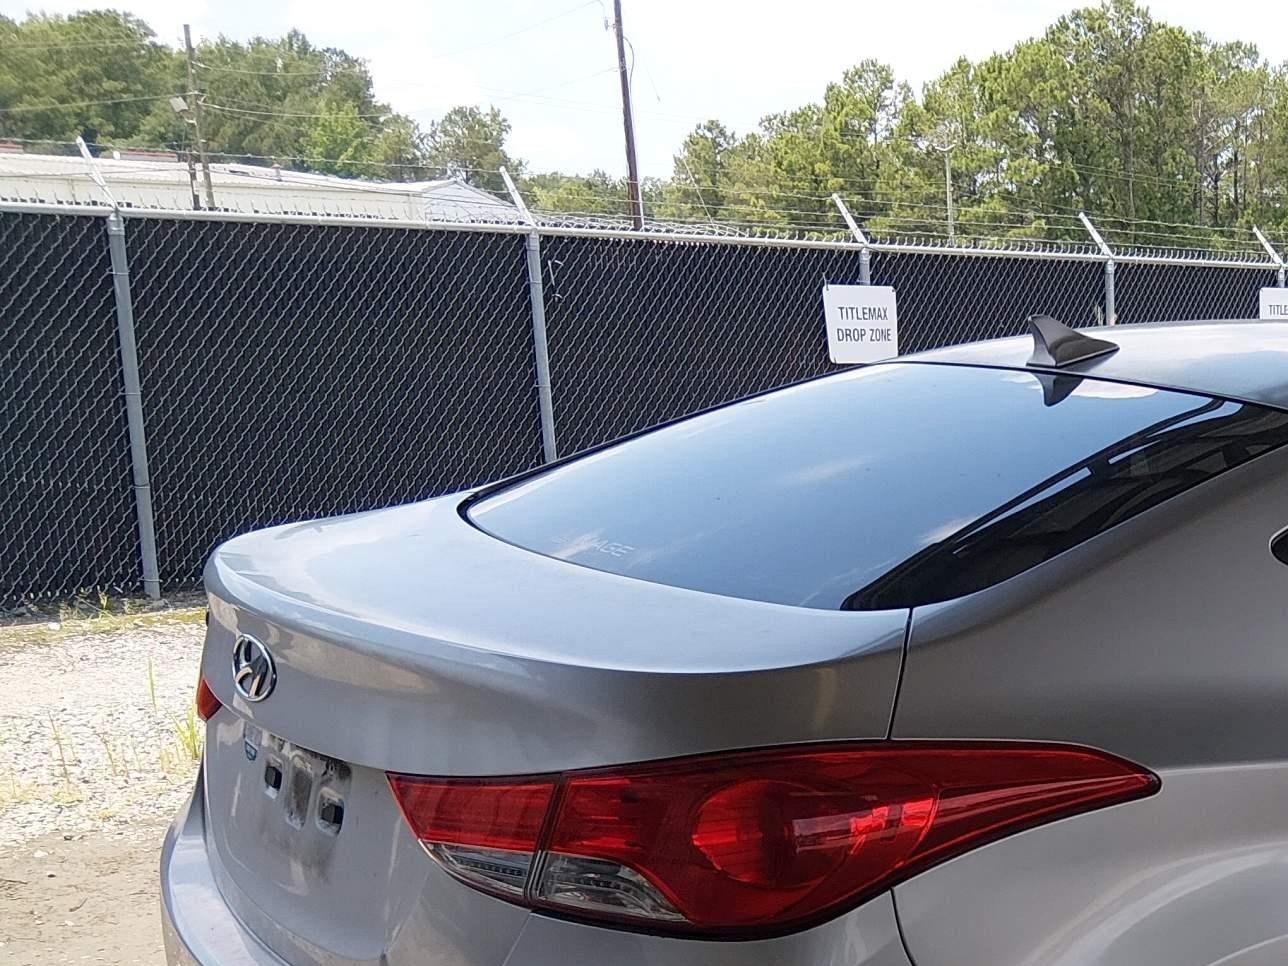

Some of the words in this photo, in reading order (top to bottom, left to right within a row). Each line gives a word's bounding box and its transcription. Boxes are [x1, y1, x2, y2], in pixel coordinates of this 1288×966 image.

[838, 307, 888, 320] TITLEMAX
[837, 328, 866, 342] DROP
[869, 328, 891, 342] ZONE
